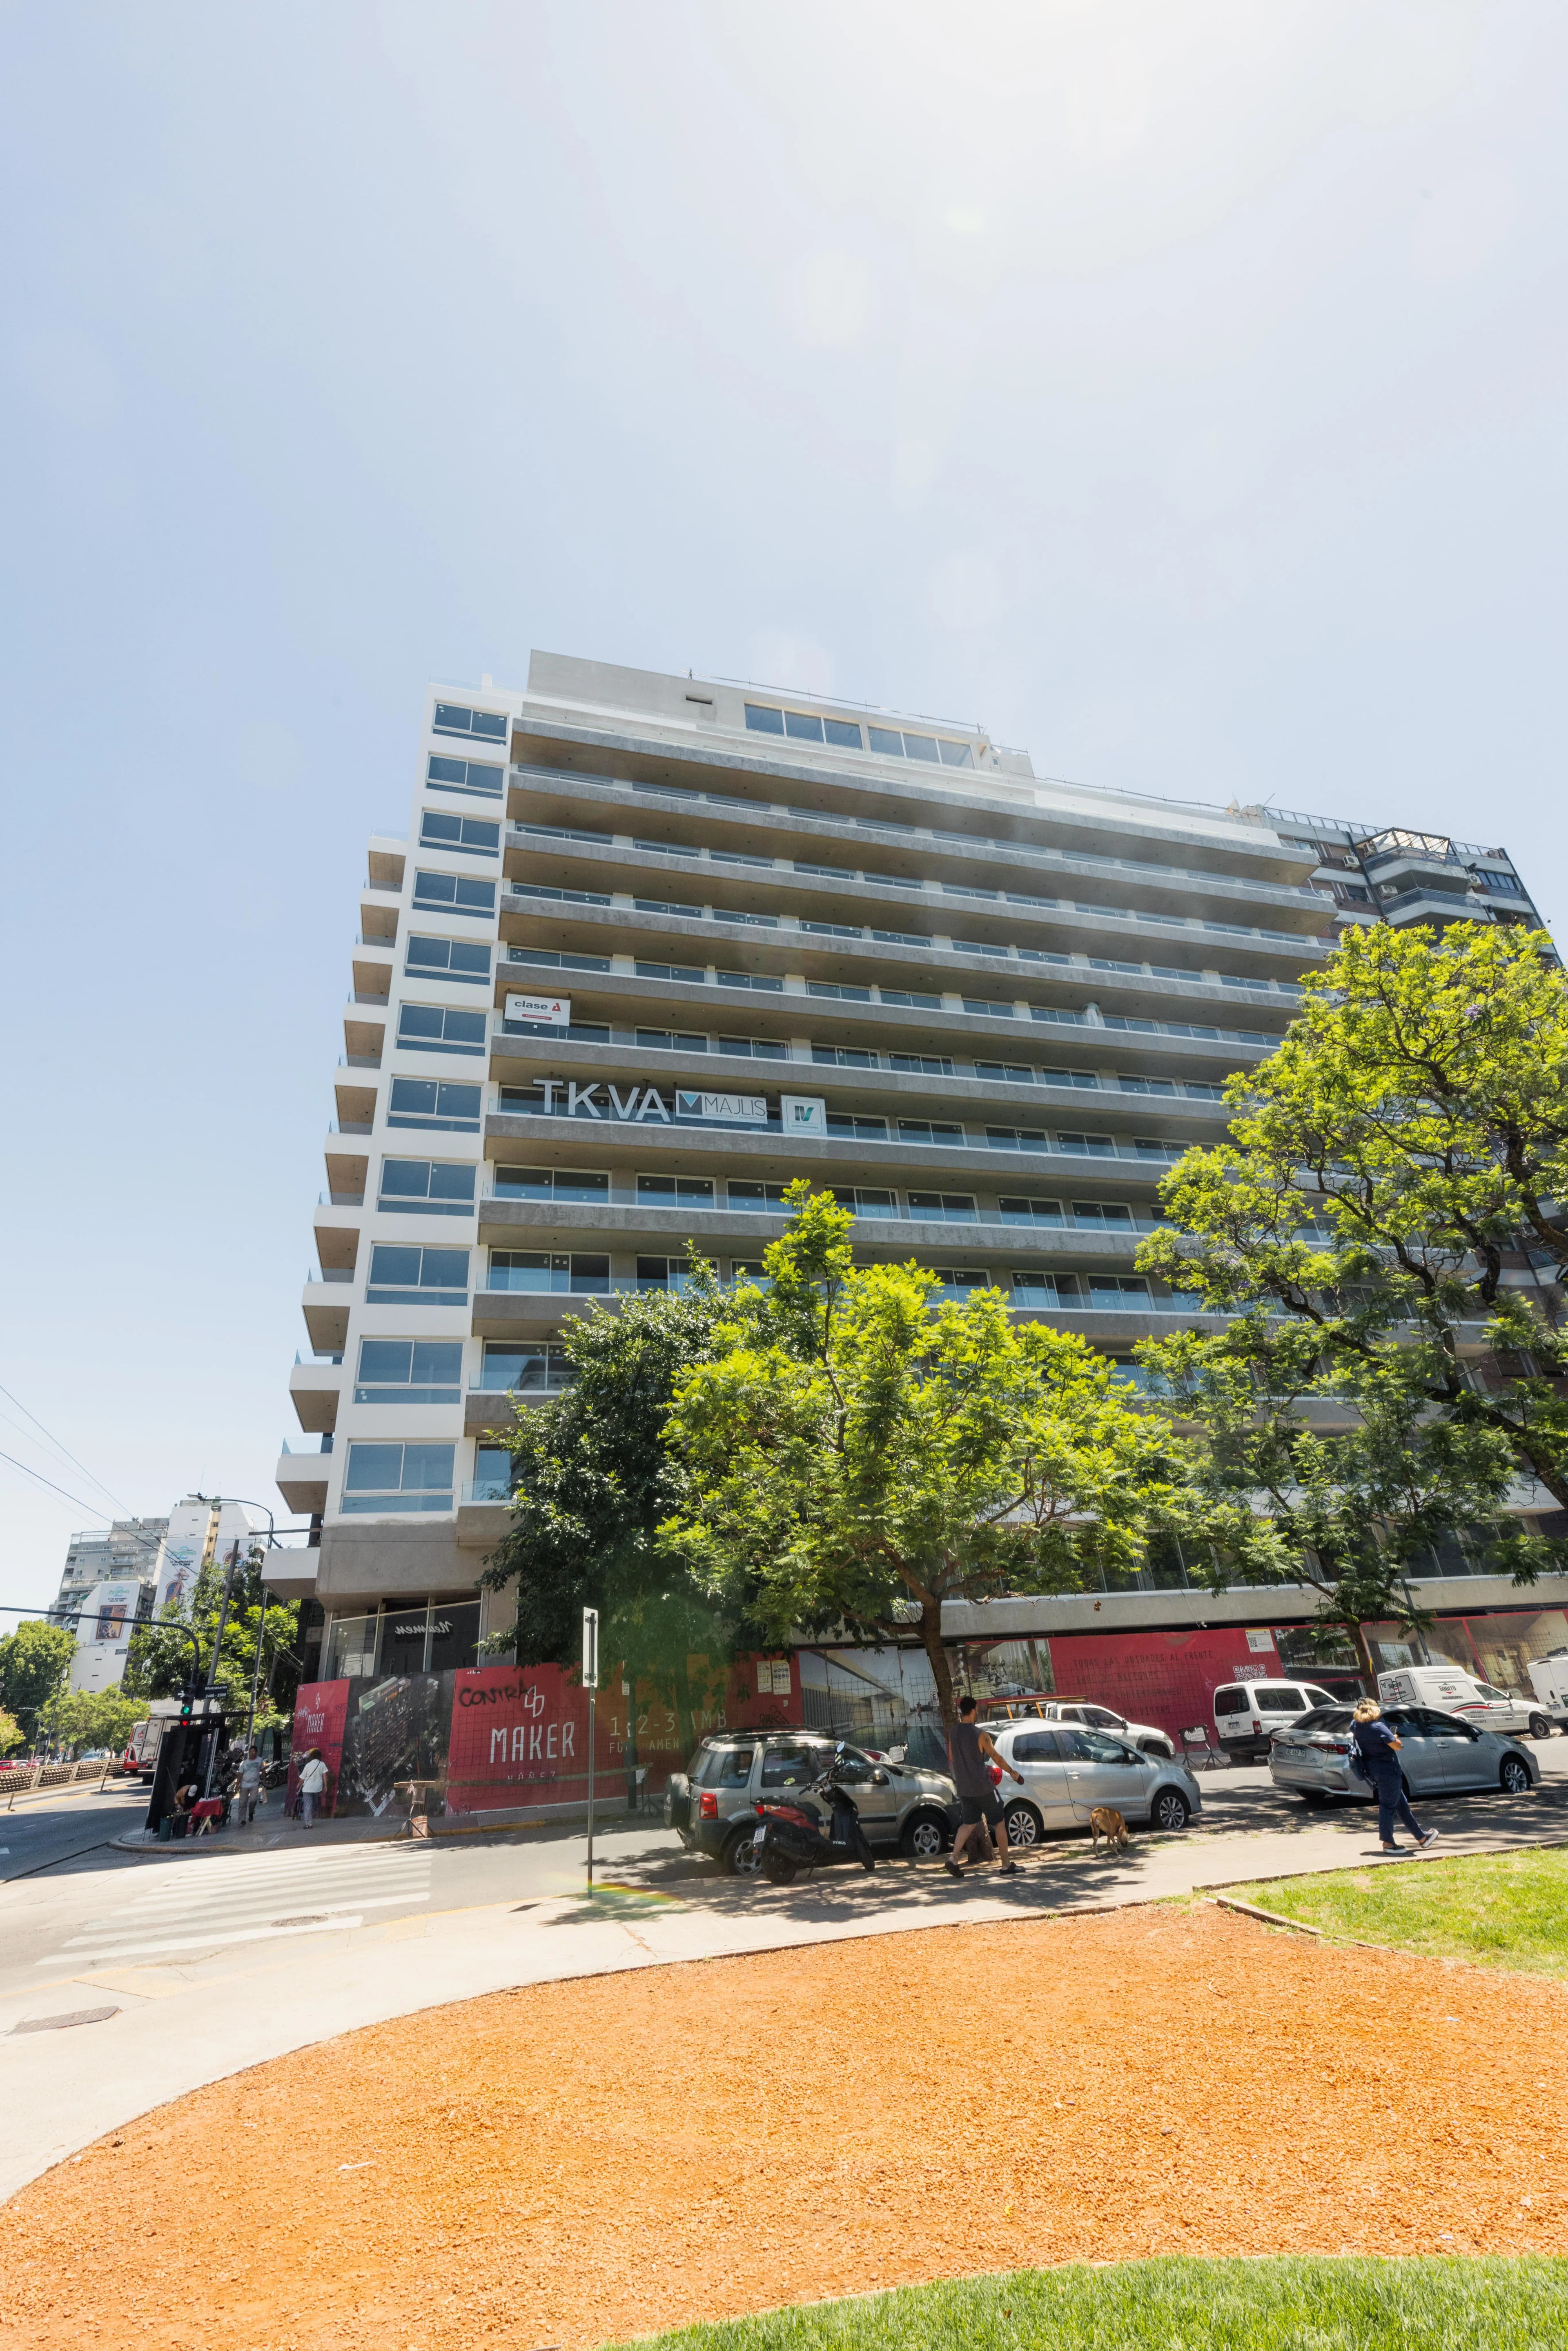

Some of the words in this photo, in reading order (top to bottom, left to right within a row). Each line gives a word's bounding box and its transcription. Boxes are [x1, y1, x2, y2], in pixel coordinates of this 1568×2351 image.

[514, 1001, 548, 1010] clase
[532, 1079, 671, 1122] TKVA
[704, 1096, 766, 1116] MAJLIS
[1074, 1658, 1099, 1668] TODAS
[1104, 1656, 1120, 1666] LAS
[1125, 1653, 1165, 1664] UNIDADES
[1185, 1651, 1213, 1660] FRENTE
[307, 1713, 325, 1734] MAKER
[490, 1721, 575, 1763] MAKER
